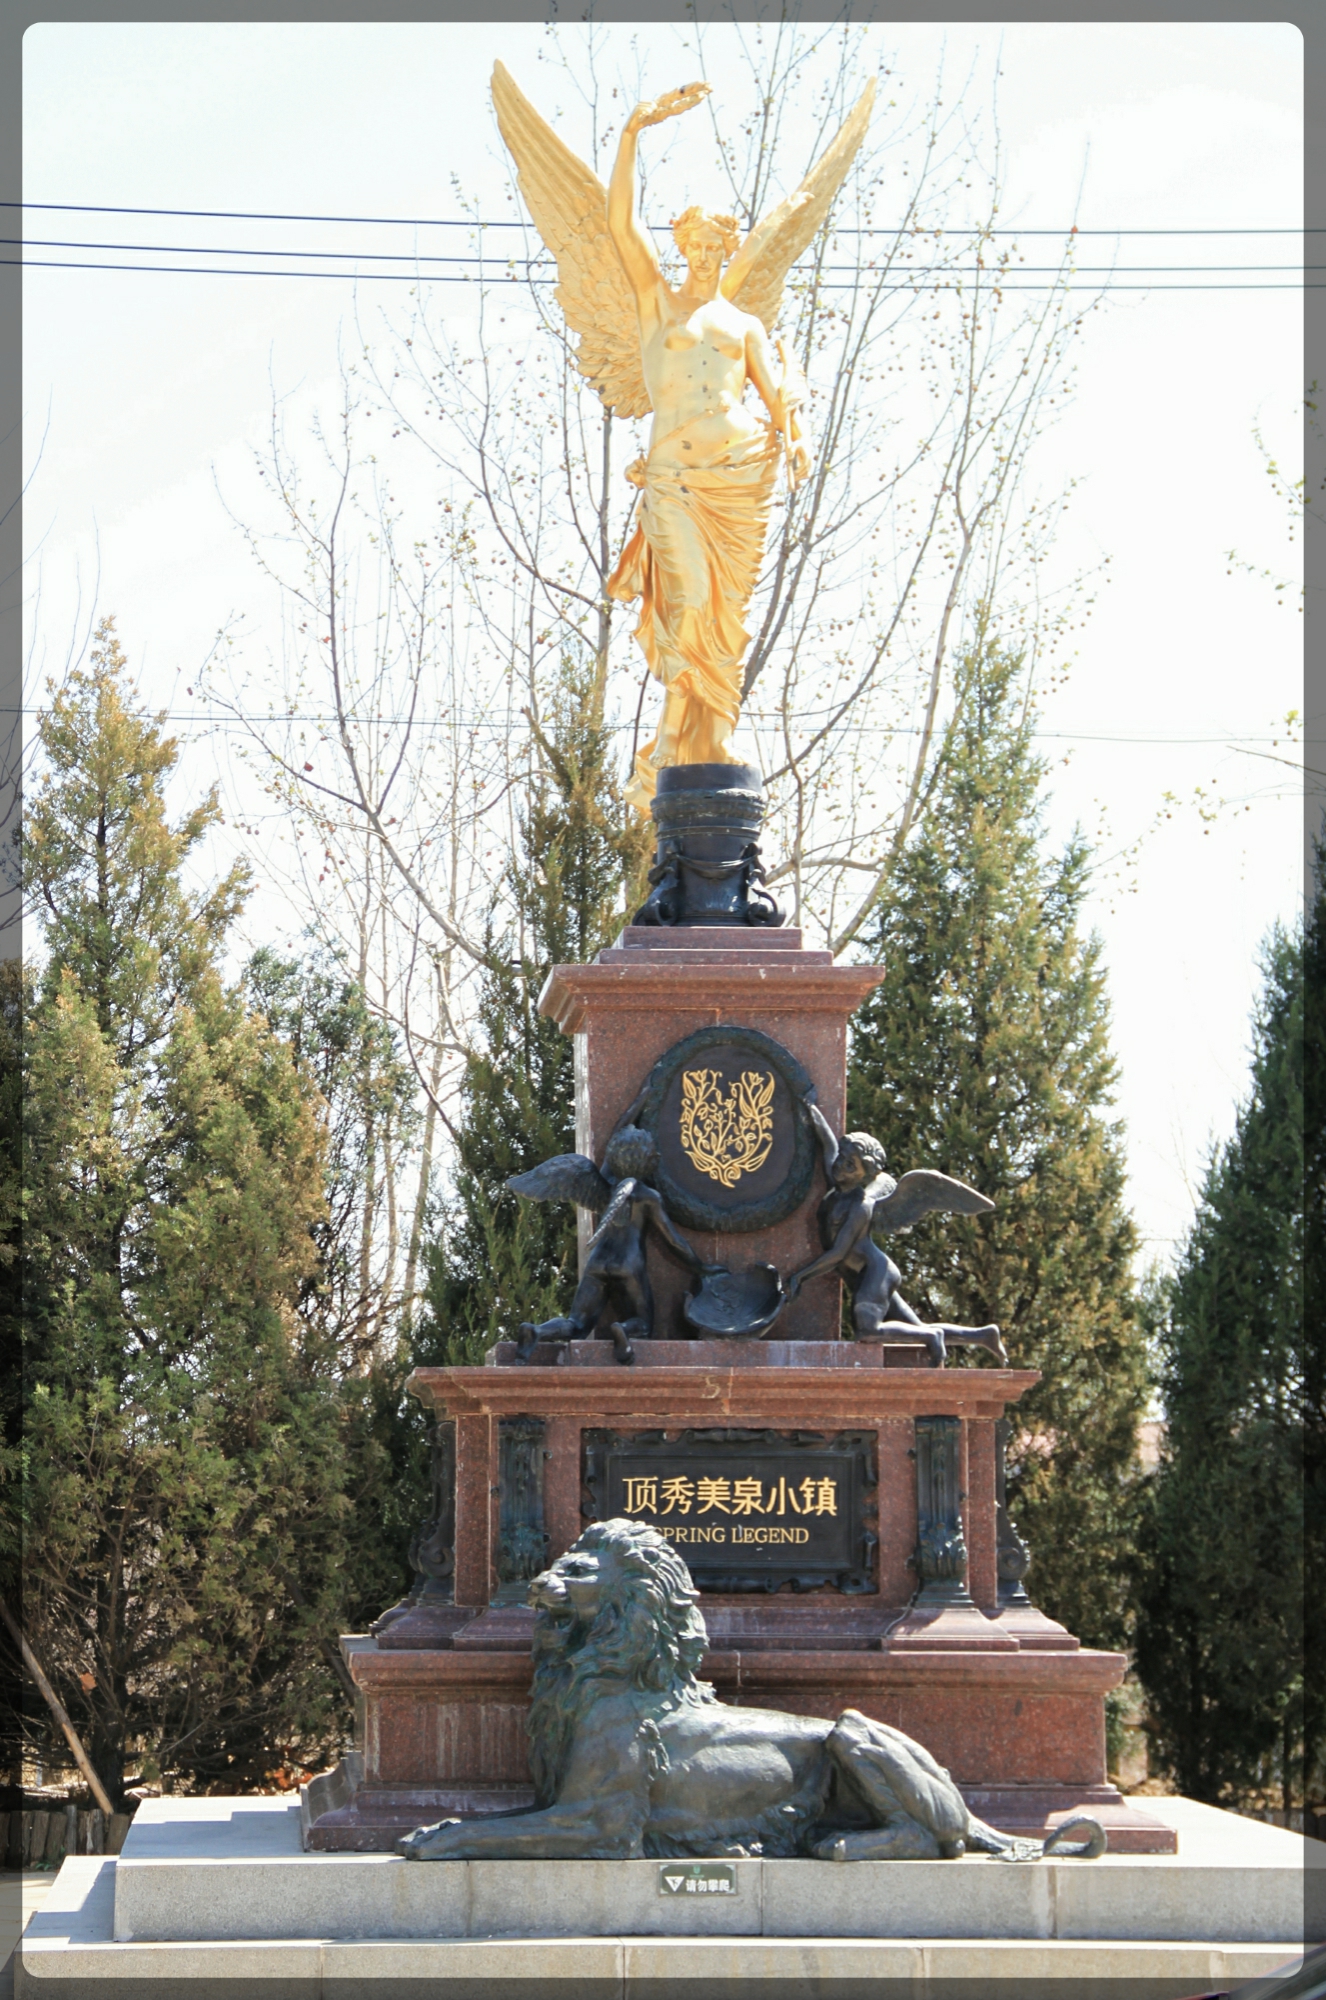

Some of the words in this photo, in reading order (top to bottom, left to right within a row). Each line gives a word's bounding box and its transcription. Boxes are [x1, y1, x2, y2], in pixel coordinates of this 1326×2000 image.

[622, 1476, 838, 1516] 顶秀美泉小镇
[731, 1527, 810, 1543] LEGEND
[685, 1879, 730, 1892] 请勿攀爬
